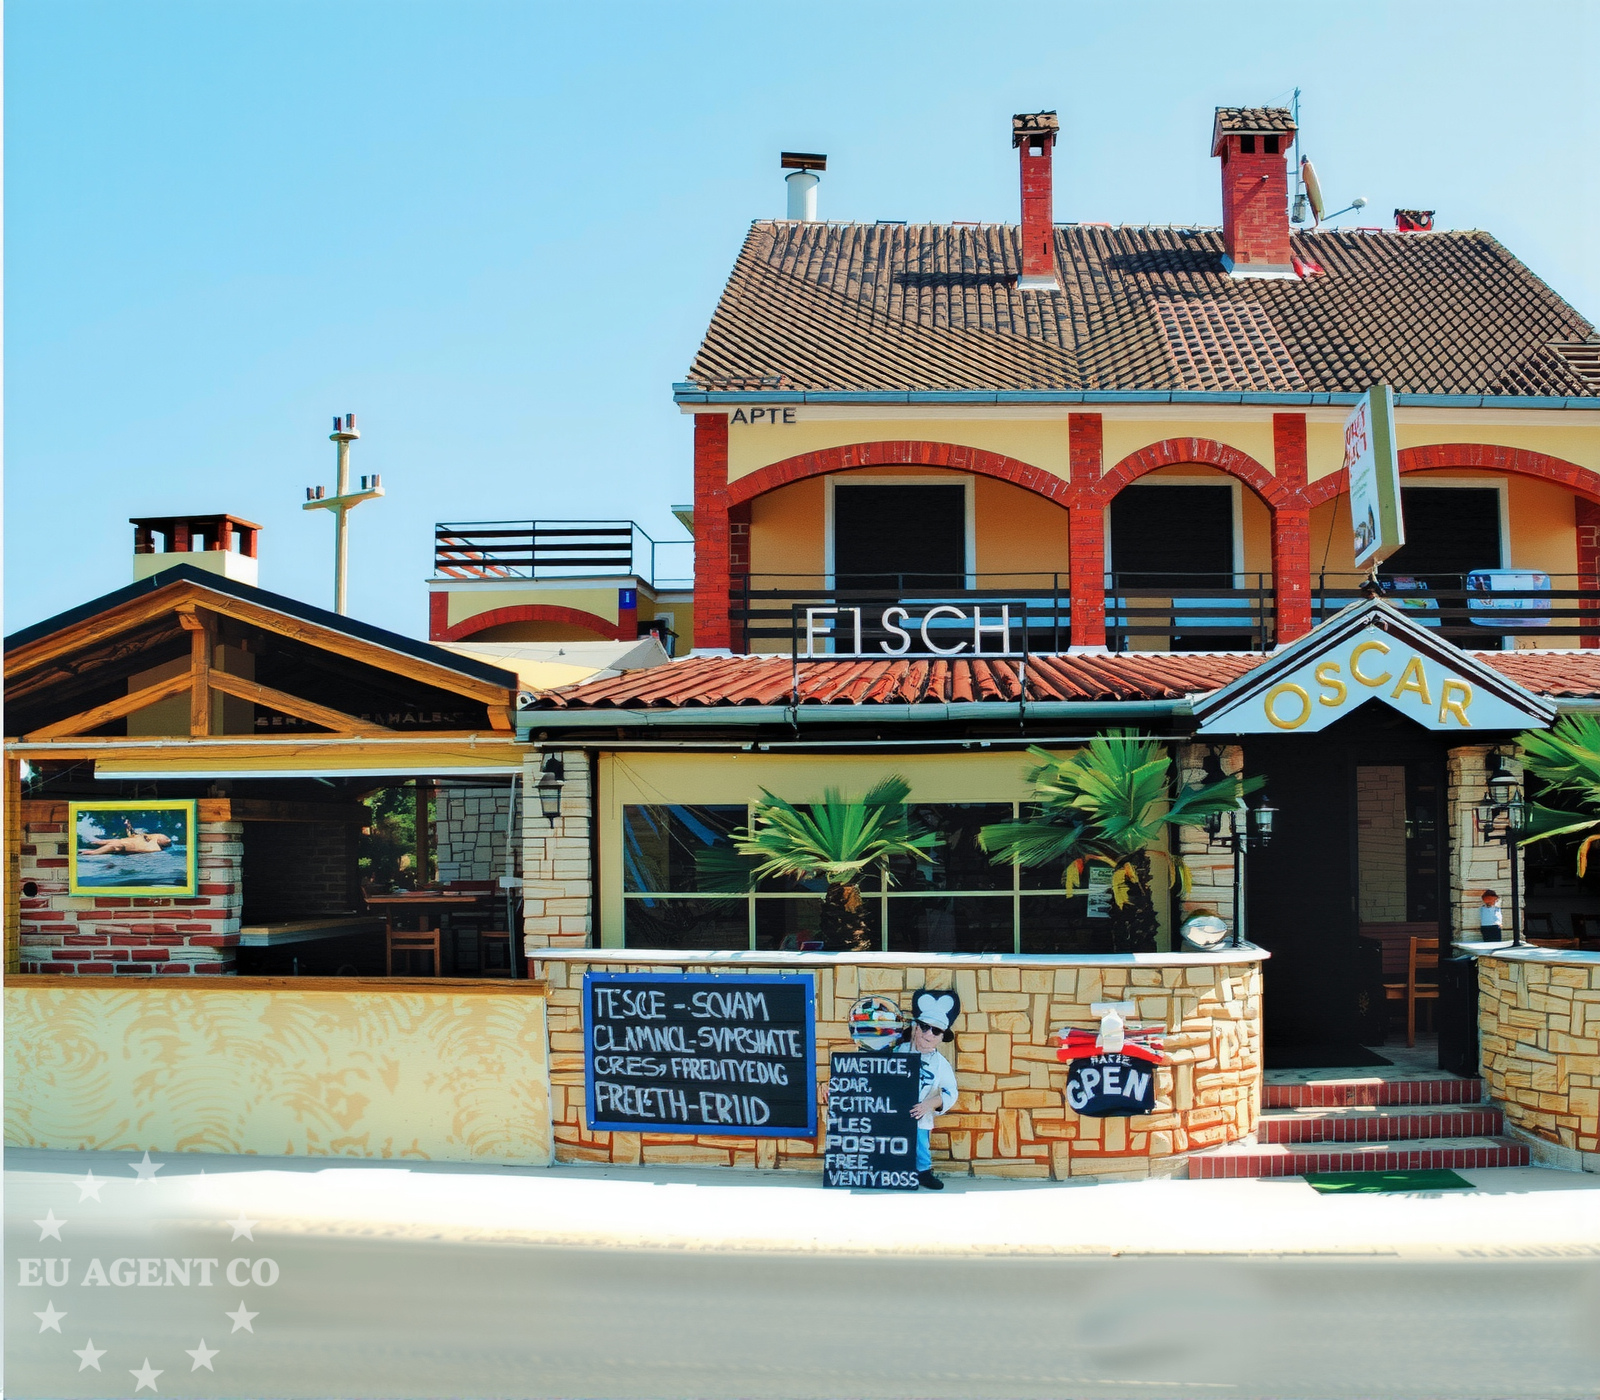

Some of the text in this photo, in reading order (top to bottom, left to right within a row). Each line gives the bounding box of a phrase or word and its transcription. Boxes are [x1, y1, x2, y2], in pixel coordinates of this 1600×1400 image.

[730, 407, 797, 425] APTE
[1264, 640, 1472, 729] OSCAR
[825, 1134, 909, 1155] POSTO
[880, 1171, 919, 1187] BOSS
